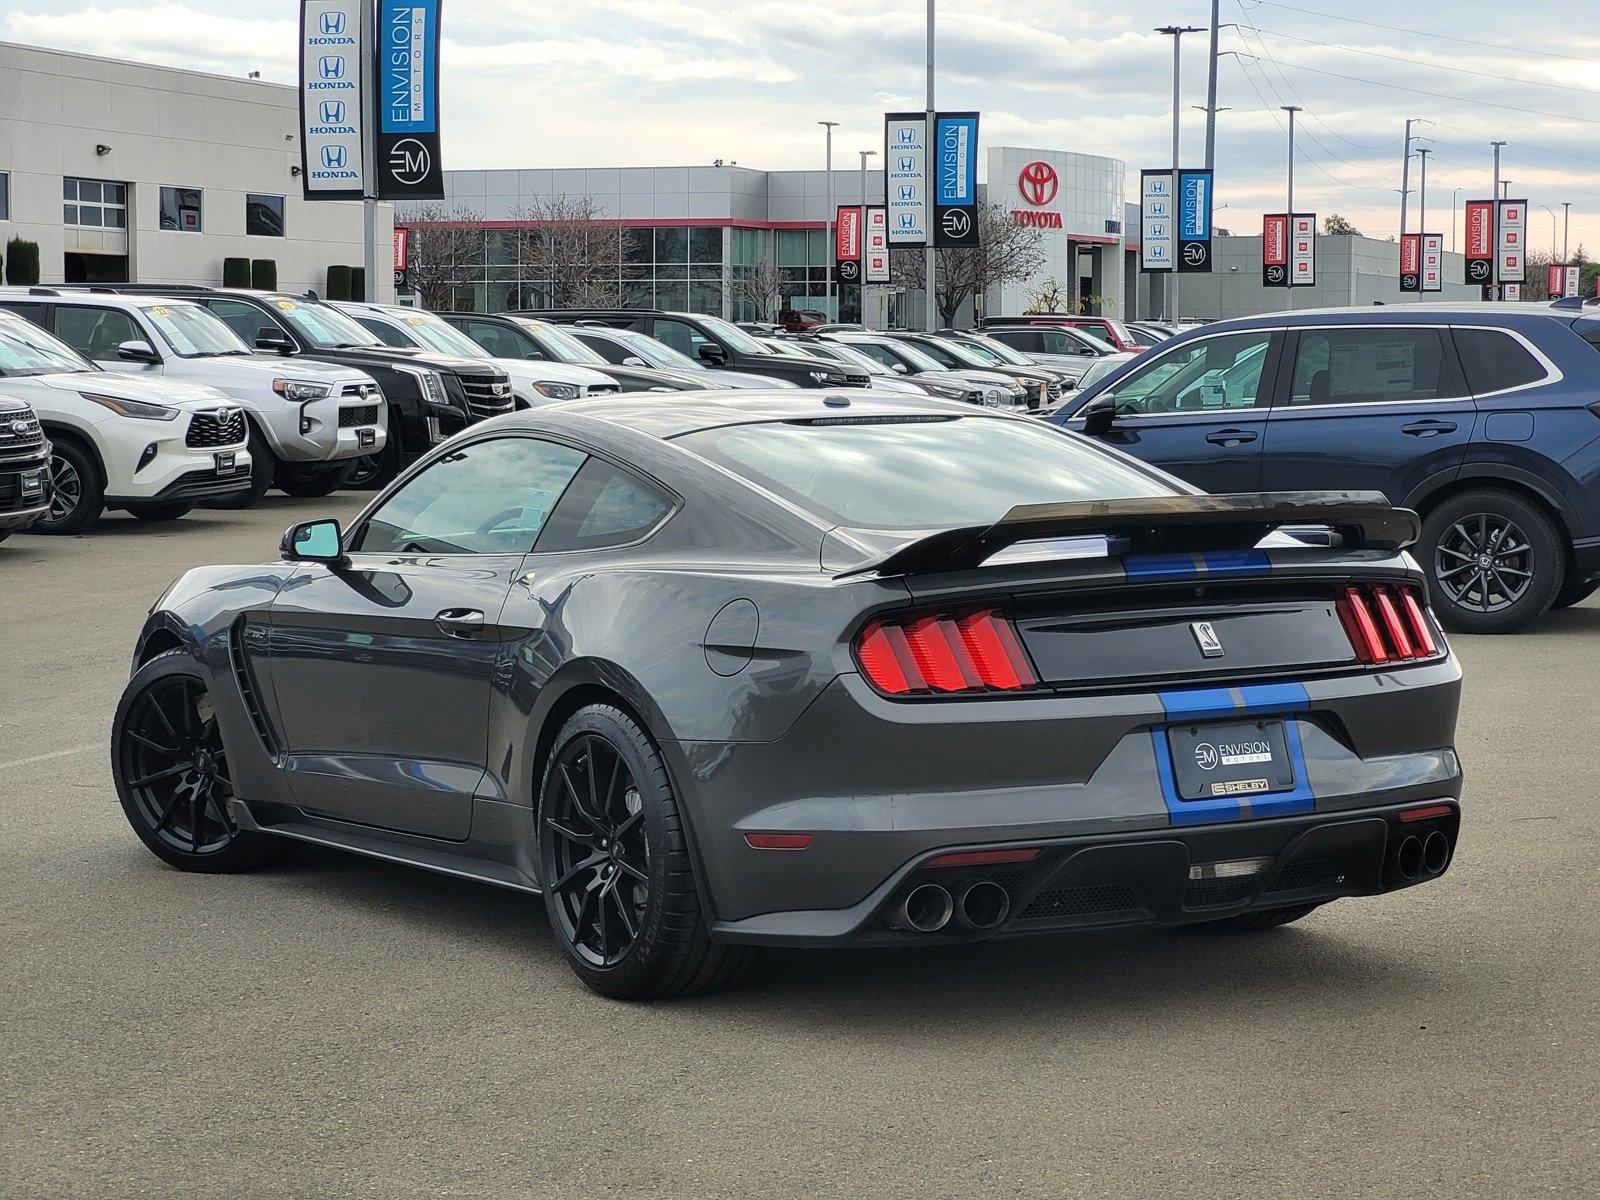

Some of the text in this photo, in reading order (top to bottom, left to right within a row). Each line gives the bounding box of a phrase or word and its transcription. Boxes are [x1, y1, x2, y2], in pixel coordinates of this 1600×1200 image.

[308, 37, 356, 45] HONDA
[392, 8, 410, 122] ENVISION
[414, 18, 422, 112] MOTORS
[308, 82, 355, 90] HONDA
[309, 126, 356, 134] HONDA
[311, 171, 358, 179] HONDA
[944, 125, 958, 199] ENVISION
[1010, 210, 1063, 228] TOYOTA
[1186, 179, 1196, 235] ENVISION
[842, 212, 850, 256] ENVISION
[1268, 221, 1276, 261] ENVISION
[1472, 208, 1480, 255] ENVISION
[1219, 741, 1270, 756] ENVISION
[1225, 781, 1265, 793] SHELBY
